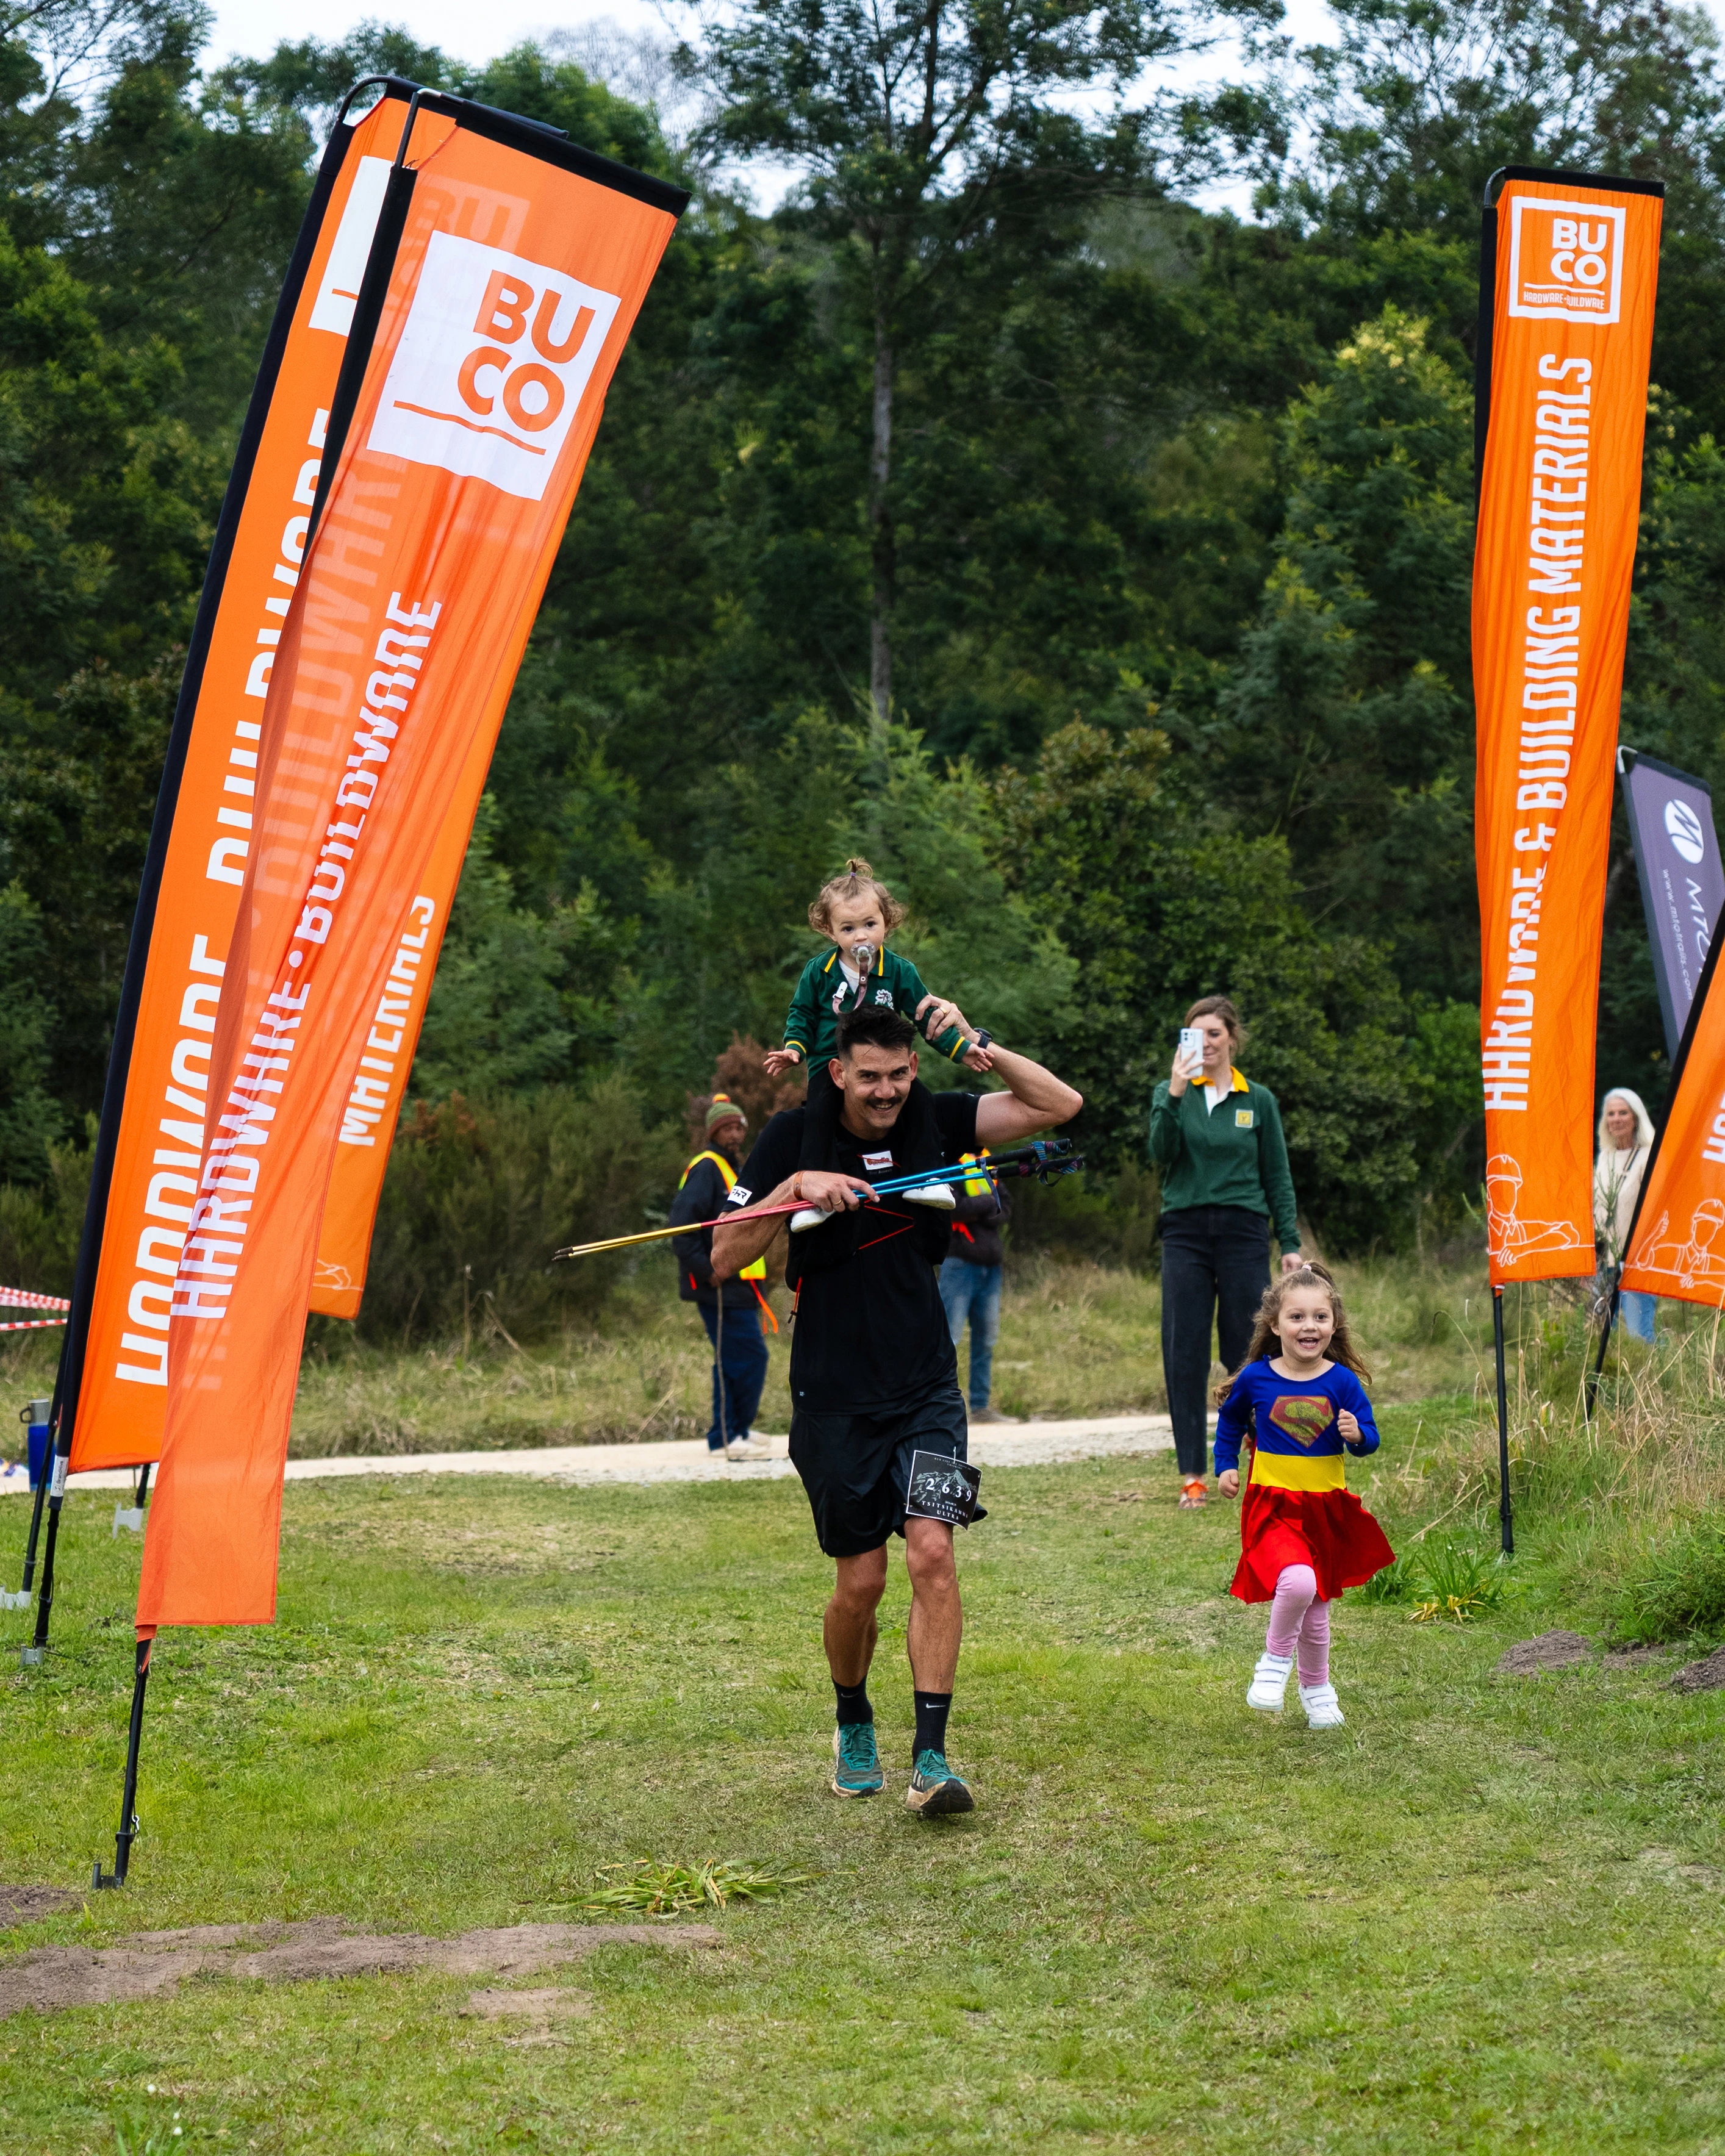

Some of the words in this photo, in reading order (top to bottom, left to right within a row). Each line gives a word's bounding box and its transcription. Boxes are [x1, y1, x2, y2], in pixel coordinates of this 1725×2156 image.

[1551, 251, 1607, 285] CO
[1552, 219, 1607, 252] BU
[473, 270, 595, 364] BU
[1524, 291, 1563, 304] HARDWARE
[1566, 295, 1605, 309] BUILDWARE
[457, 346, 565, 432] CO
[1528, 353, 1592, 593] MATERIALS
[1517, 606, 1581, 810] BUILDING
[170, 983, 310, 1319] HARDWARE
[294, 592, 442, 945] BUILDWARE
[1482, 861, 1549, 1111] HARDWARE
[926, 1478, 972, 1502] 2639
[937, 1510, 959, 1520] ULTRA
